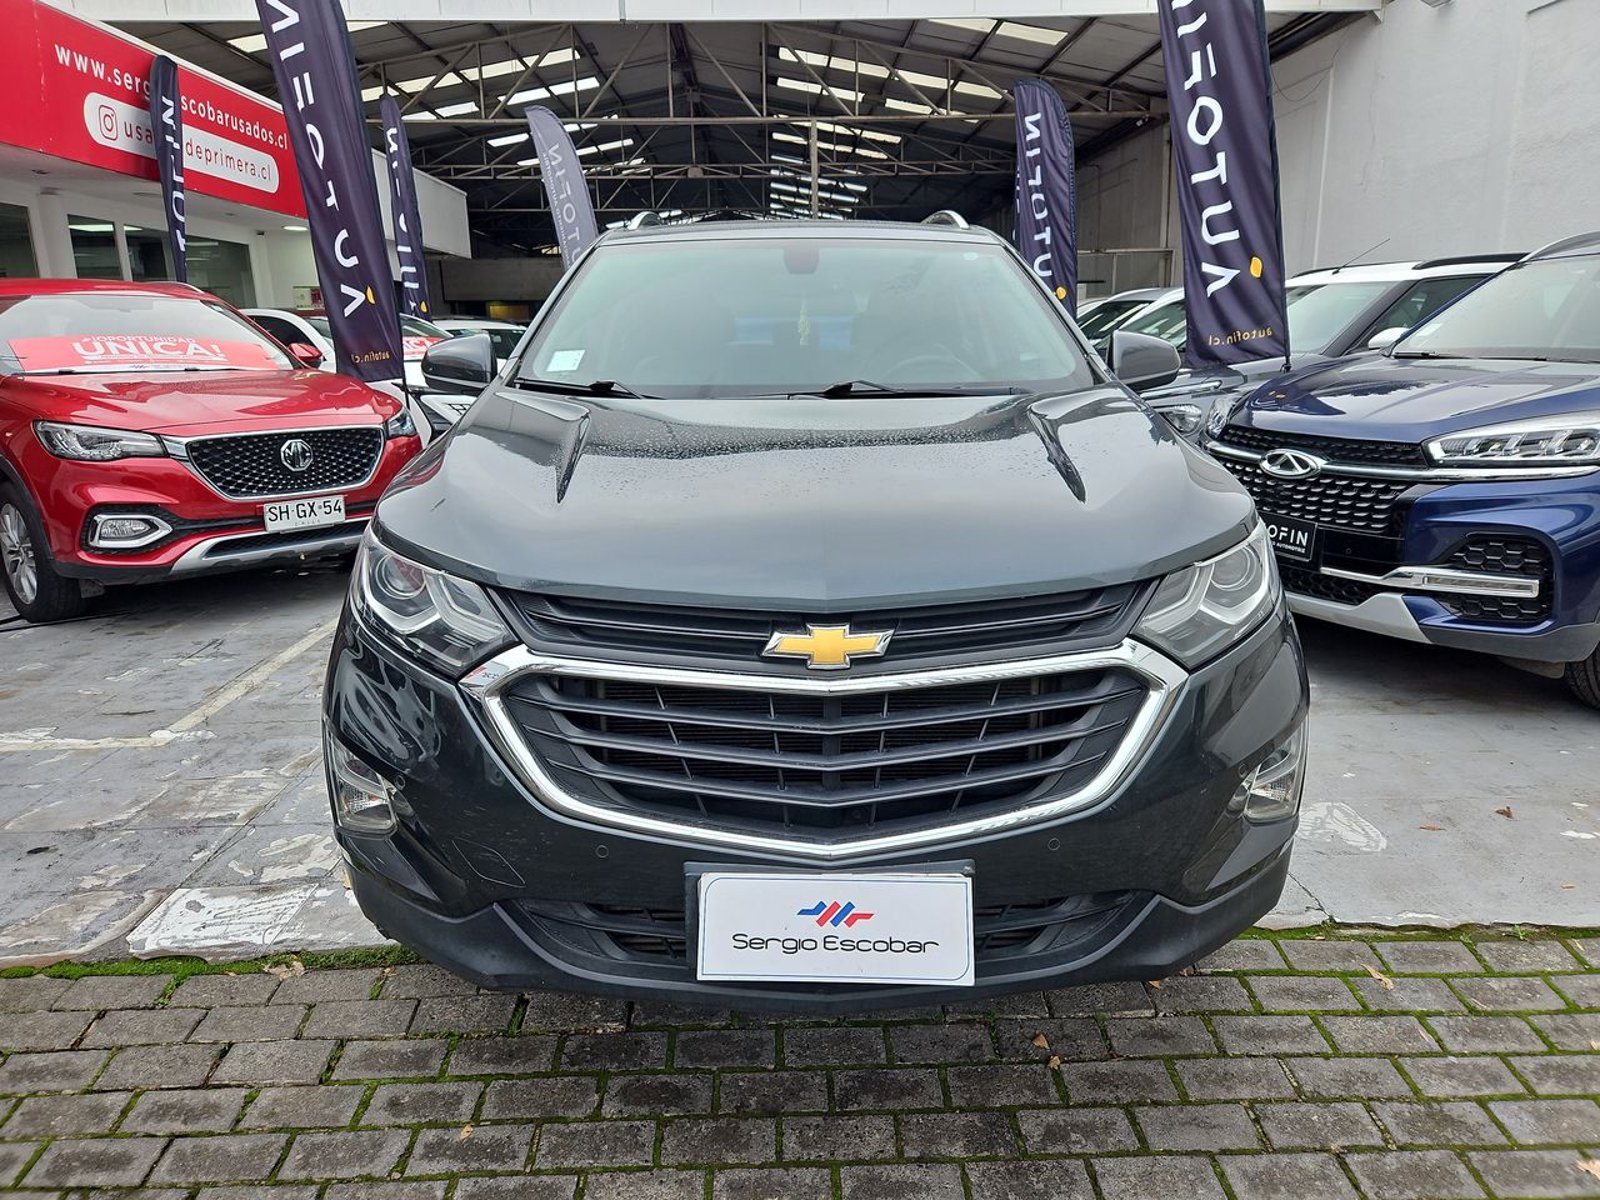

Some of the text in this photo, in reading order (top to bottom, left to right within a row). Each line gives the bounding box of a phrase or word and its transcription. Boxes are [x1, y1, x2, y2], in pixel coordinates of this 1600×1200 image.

[1267, 524, 1308, 547] OFIN
[732, 933, 939, 954] Sergio Escobar
